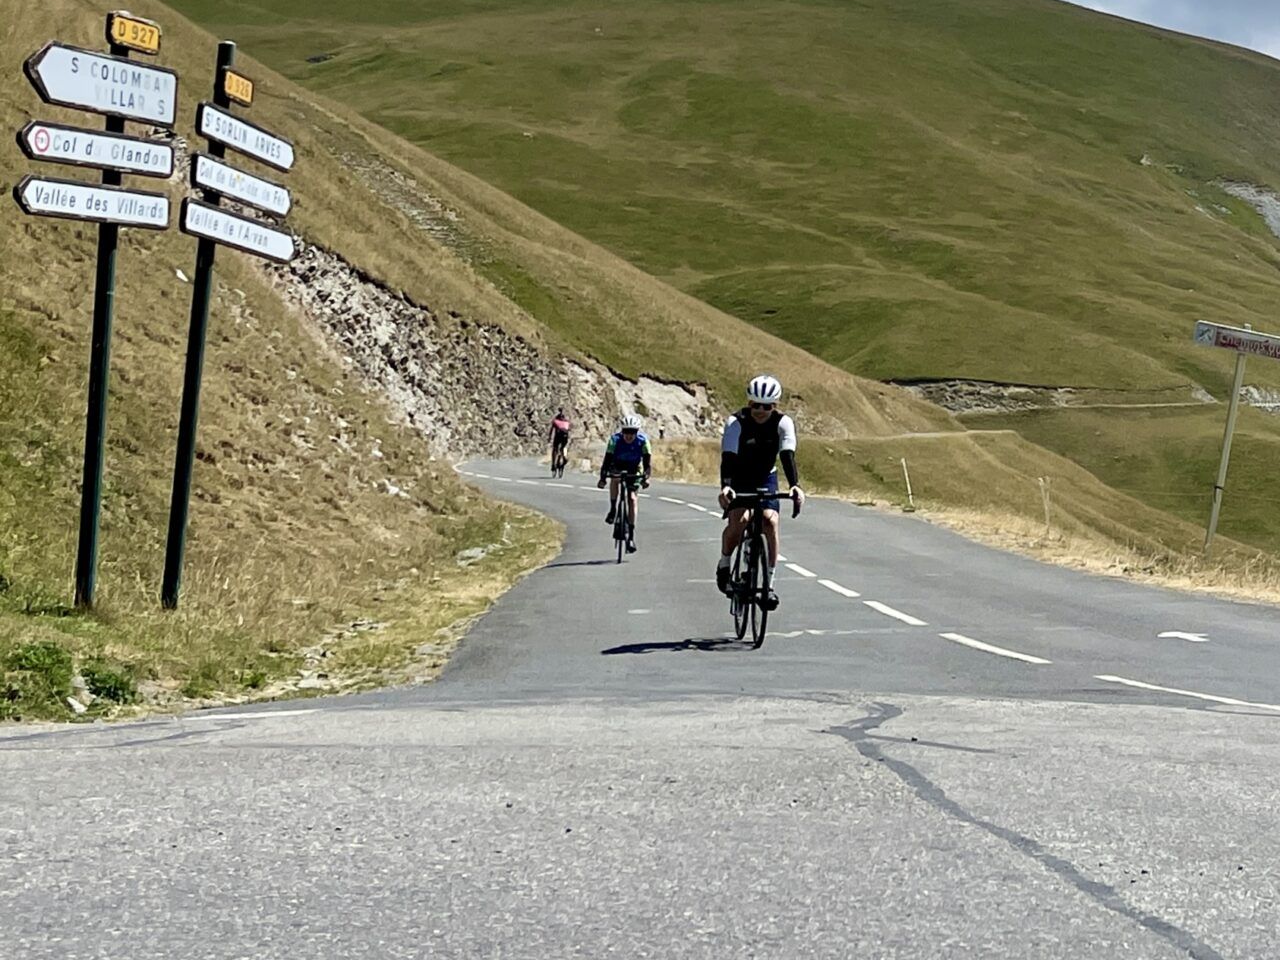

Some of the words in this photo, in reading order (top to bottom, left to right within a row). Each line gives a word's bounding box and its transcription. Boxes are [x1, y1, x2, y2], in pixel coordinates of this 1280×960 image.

[119, 21, 126, 37] D
[132, 25, 155, 45] 927
[53, 135, 77, 153] Col
[111, 144, 167, 166] Glandon
[215, 117, 248, 144] SORLIN
[255, 135, 281, 159] ARVES
[35, 186, 76, 207] Vallée
[86, 194, 108, 212] des
[117, 197, 164, 219] Villards
